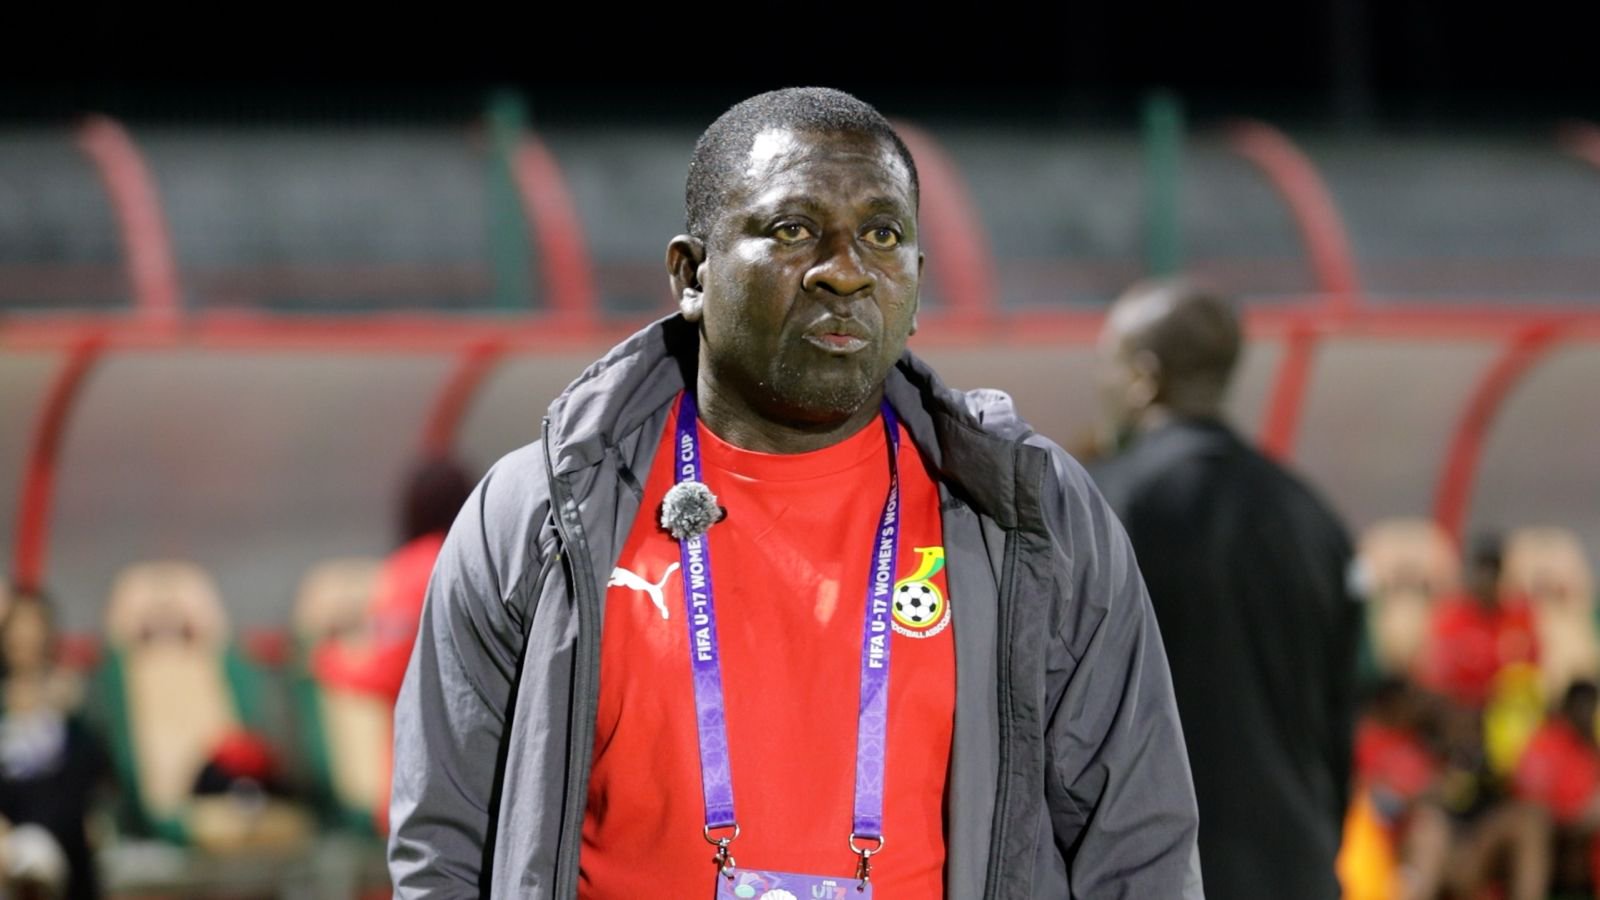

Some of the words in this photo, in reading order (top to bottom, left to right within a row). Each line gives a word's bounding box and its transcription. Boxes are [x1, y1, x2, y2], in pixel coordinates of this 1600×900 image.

[687, 536, 706, 589] WOME
[874, 526, 895, 597] WOMEN'S
[692, 591, 709, 625] U-17
[871, 599, 888, 632] U-17
[696, 626, 713, 662] FIFA
[868, 634, 885, 669] FIFA
